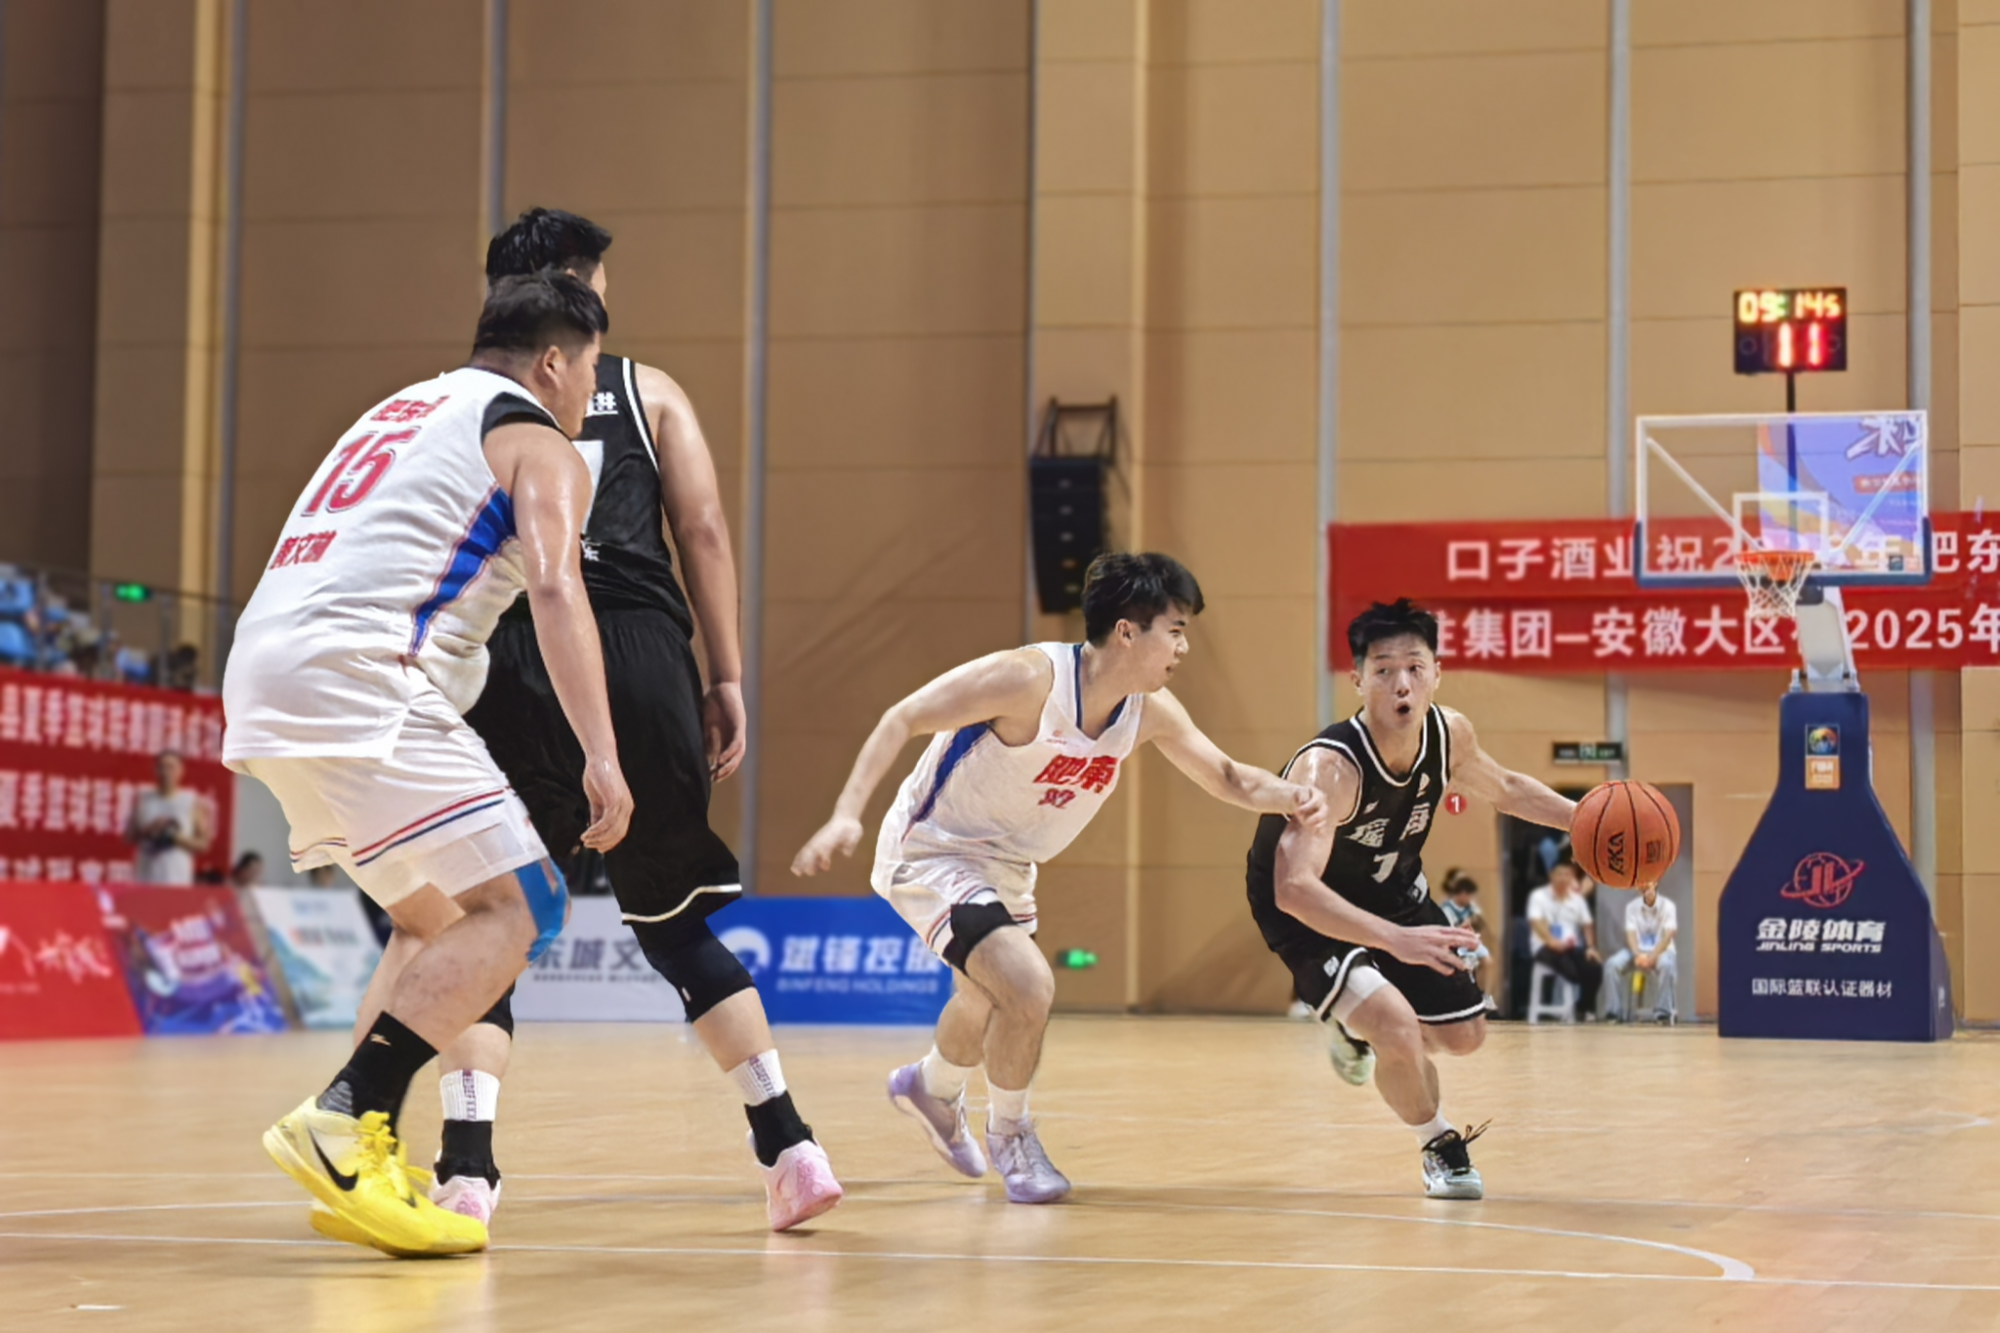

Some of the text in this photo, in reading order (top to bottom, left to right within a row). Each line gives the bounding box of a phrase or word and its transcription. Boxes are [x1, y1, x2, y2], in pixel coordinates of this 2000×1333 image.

[300, 426, 422, 518] 15
[1450, 795, 1460, 813] 1
[1371, 851, 1399, 883] 7
[1756, 917, 1886, 942] 金陵体育
[1756, 941, 1882, 953] JINLING SPORTS
[1751, 978, 1892, 998] 国际篮联认证器材
